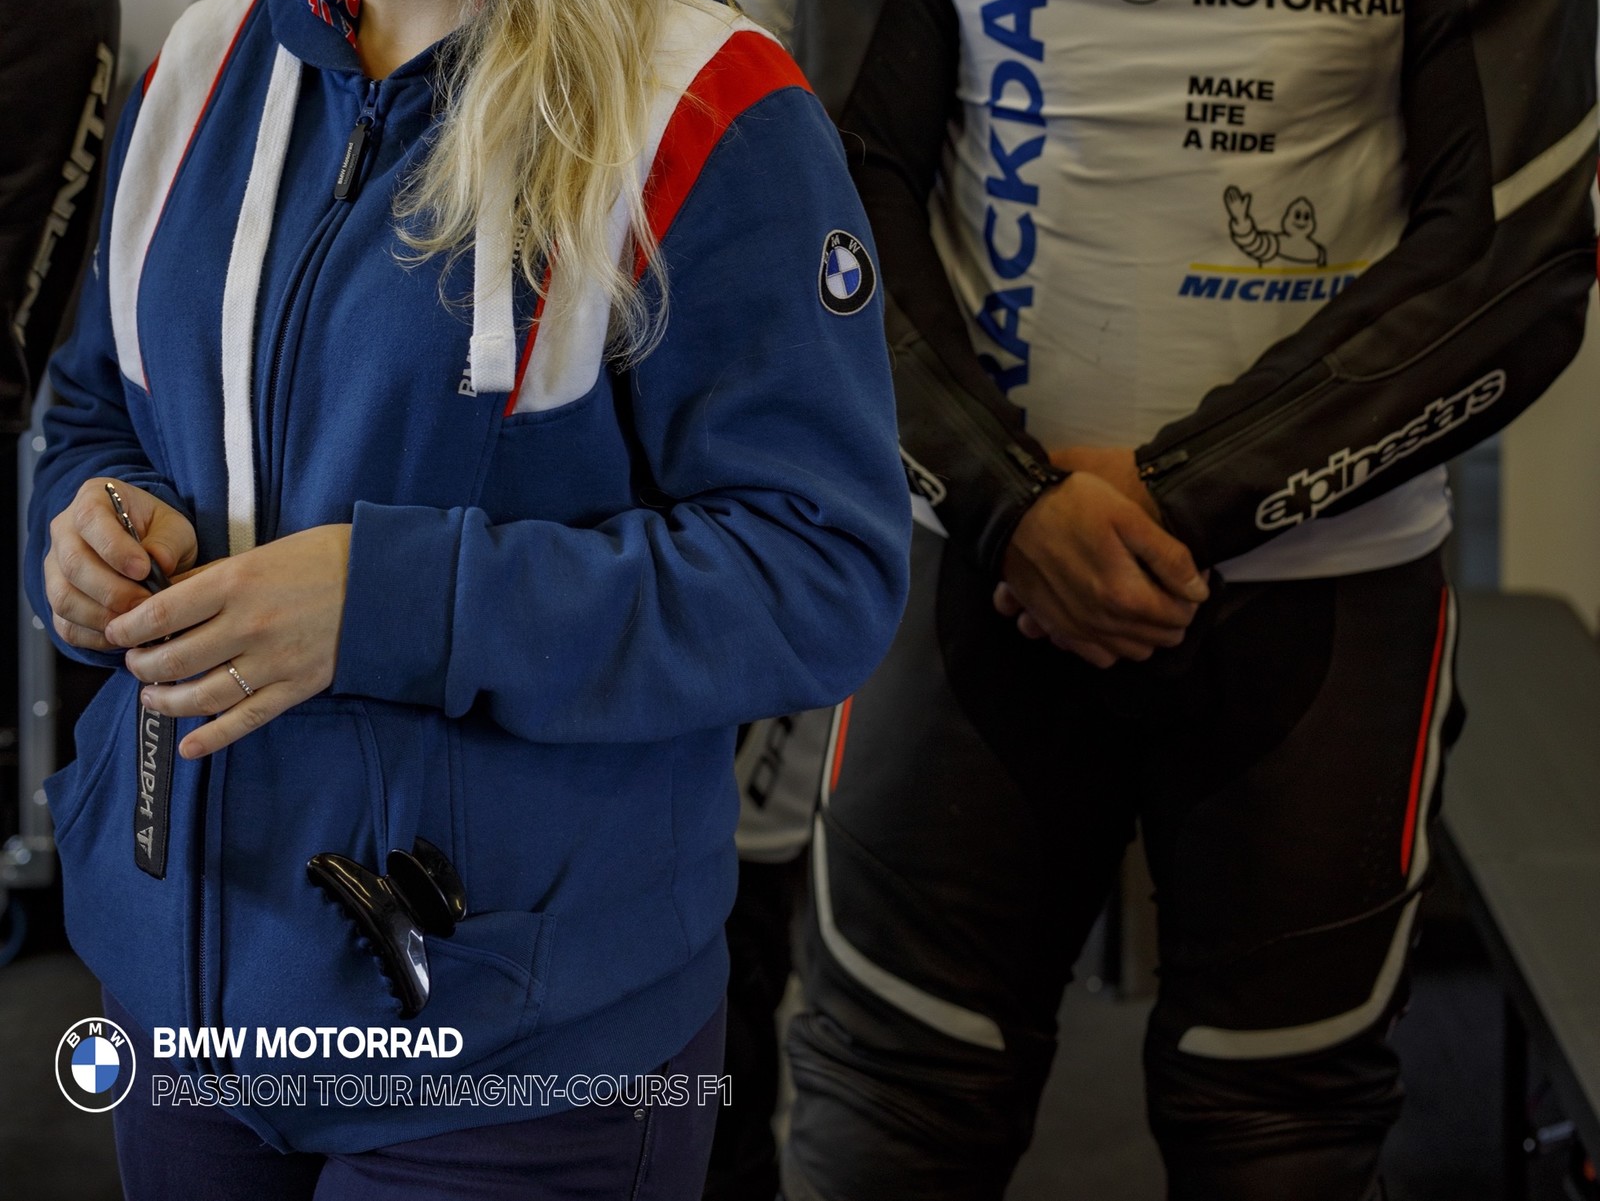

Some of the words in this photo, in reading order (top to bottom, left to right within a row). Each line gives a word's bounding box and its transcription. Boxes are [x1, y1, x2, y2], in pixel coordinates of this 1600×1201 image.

[1187, 76, 1275, 101] MAKE
[1185, 102, 1245, 126] LIFE
[1183, 128, 1203, 149] A
[1210, 130, 1276, 153] RIDE
